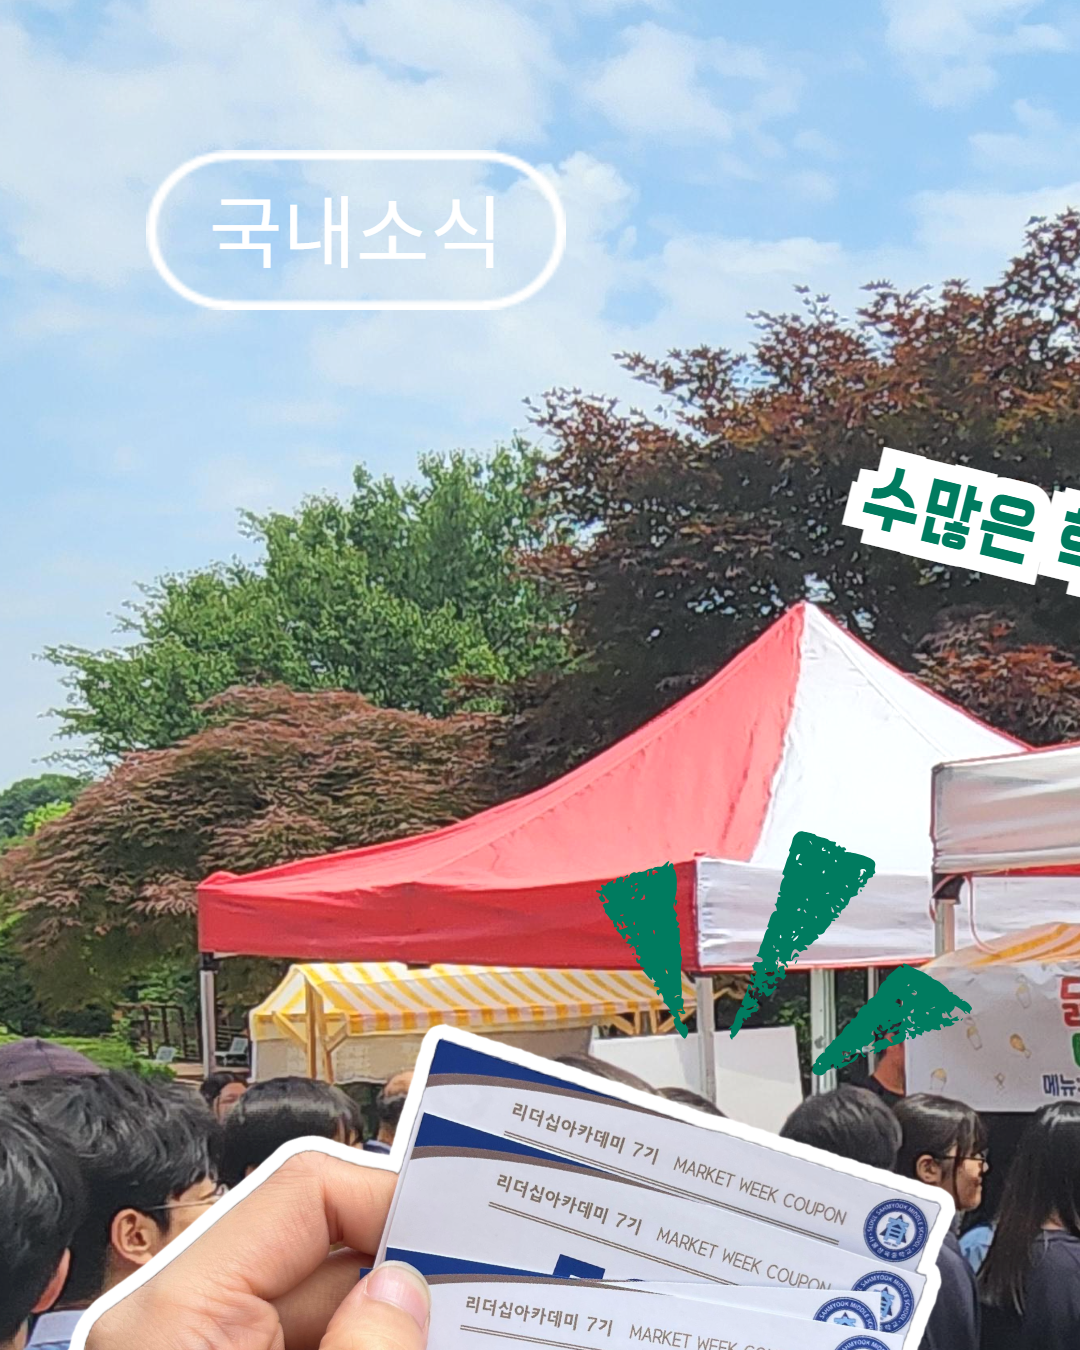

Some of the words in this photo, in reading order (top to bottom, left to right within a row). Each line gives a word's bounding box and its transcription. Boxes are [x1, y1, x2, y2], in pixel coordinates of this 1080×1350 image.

[512, 1102, 626, 1154] 리더십아카데미
[632, 1141, 659, 1165] 7기
[673, 1156, 736, 1188] MARKET
[739, 1177, 779, 1204] WEEK
[783, 1193, 847, 1226] COUPON
[497, 1174, 609, 1225] 리더십아카데미
[615, 1212, 643, 1236] 7기
[656, 1226, 718, 1259] MARKET
[722, 1248, 763, 1275] WEEK
[466, 1296, 579, 1331] 리더십아카데미
[587, 1316, 613, 1337] 7기
[629, 1324, 692, 1349] MARKET
